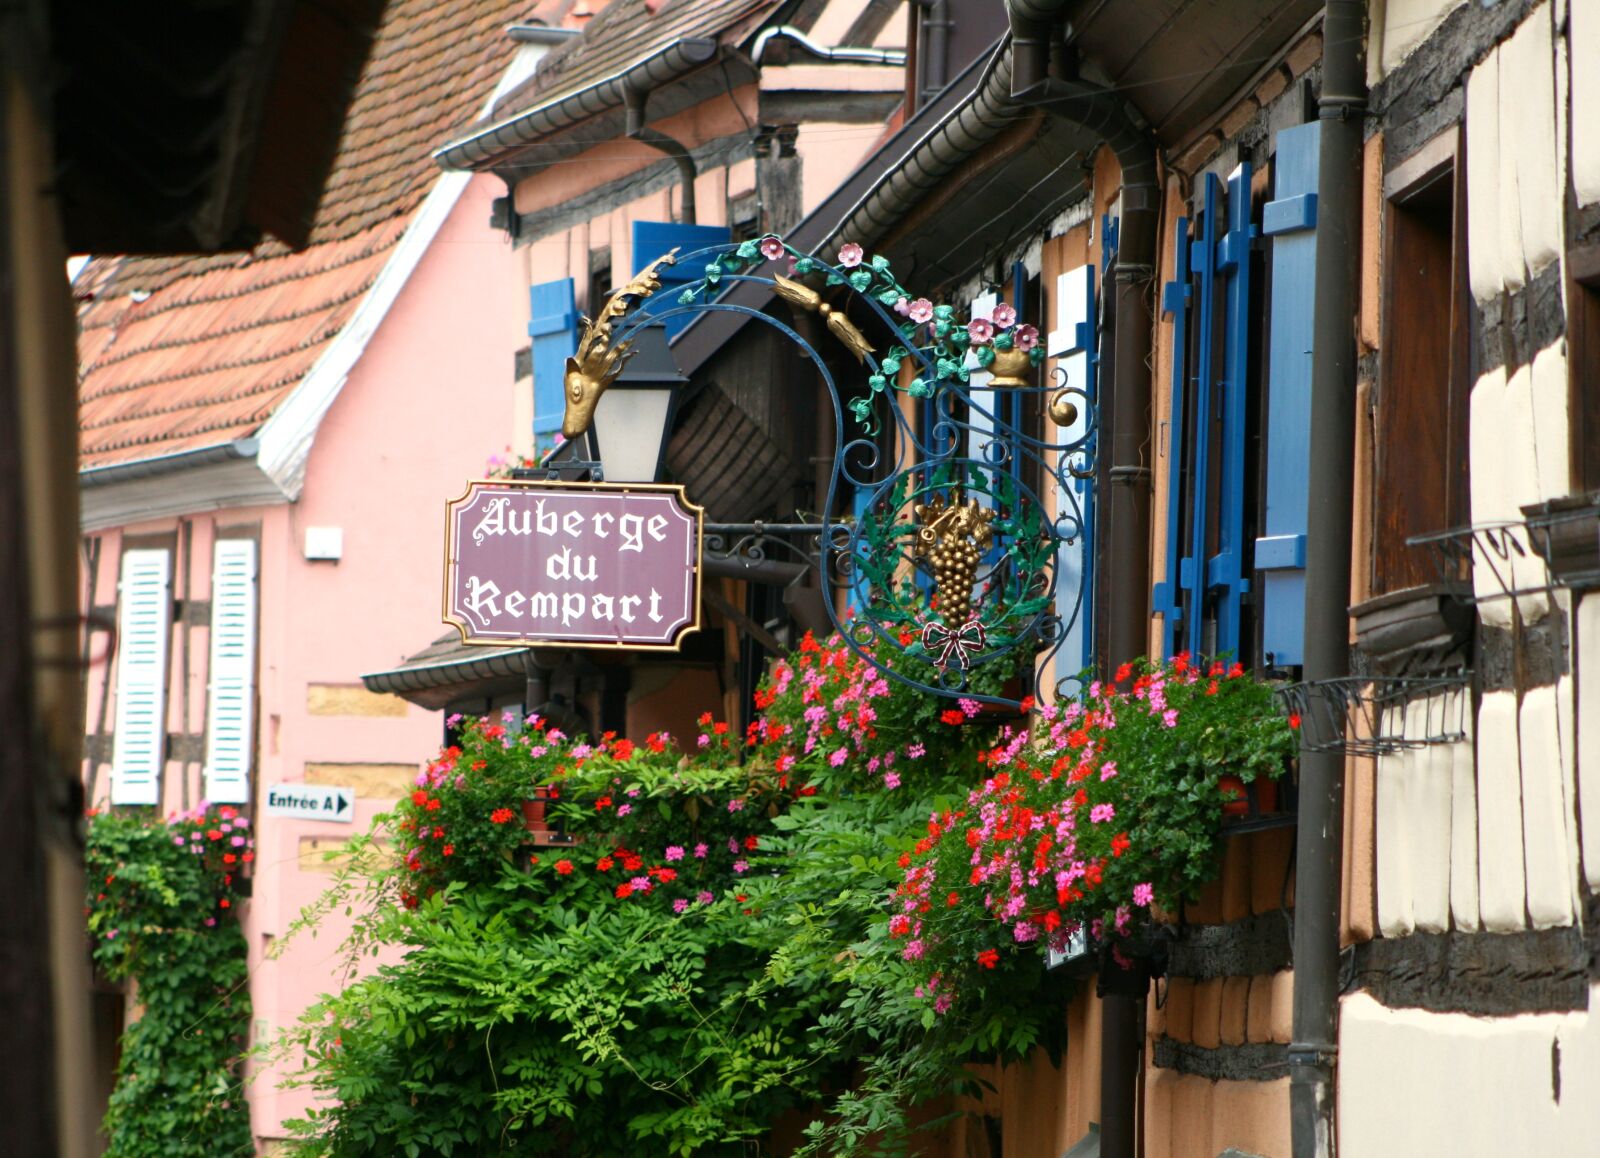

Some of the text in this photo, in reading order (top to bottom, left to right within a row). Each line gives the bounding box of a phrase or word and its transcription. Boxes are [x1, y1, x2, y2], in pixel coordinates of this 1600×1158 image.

[472, 497, 669, 552] Auberge
[546, 545, 599, 582] du
[463, 575, 664, 627] Rempart
[269, 792, 333, 811] Entrée A
